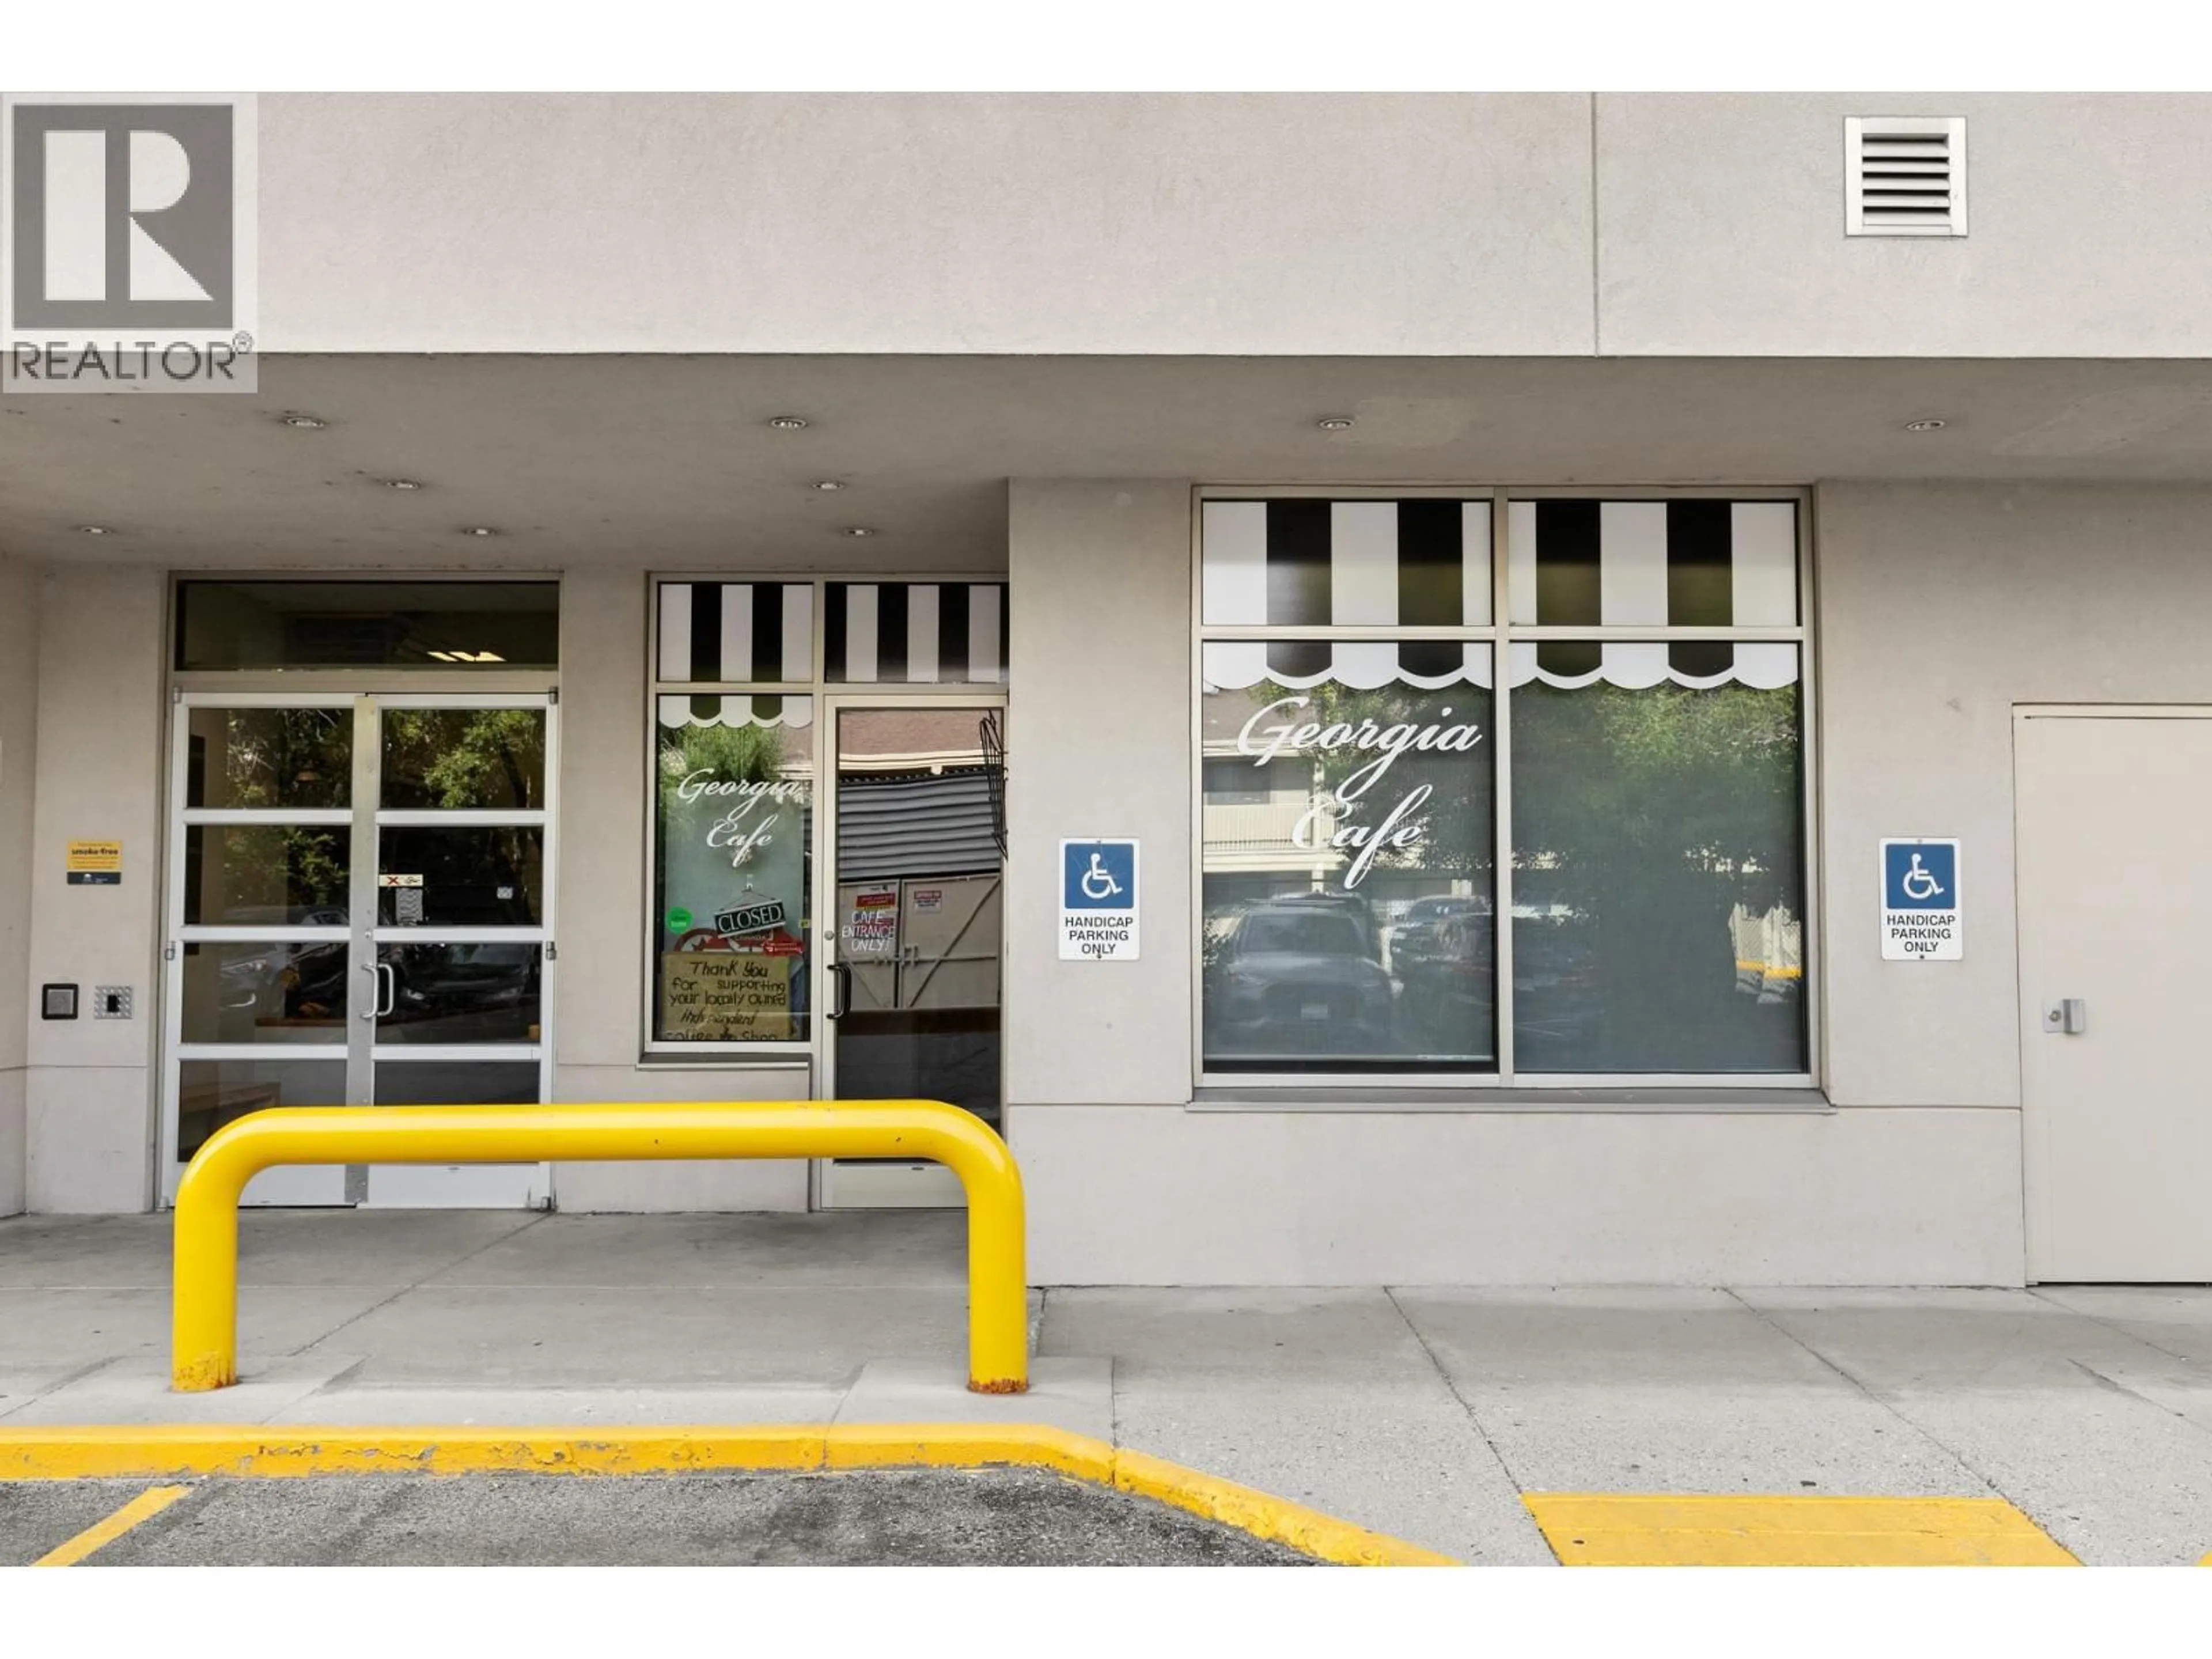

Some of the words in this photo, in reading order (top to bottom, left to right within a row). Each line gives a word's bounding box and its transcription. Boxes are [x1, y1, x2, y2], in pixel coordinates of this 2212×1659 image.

[1237, 696, 1483, 802] Georgia
[677, 768, 804, 823] Georgia
[719, 904, 782, 933] CLOSED
[1065, 916, 1134, 927] HANDICAP
[1887, 914, 1956, 926] HANDICAP
[841, 925, 895, 938] ENTRANCE
[1069, 930, 1129, 941] PARKING
[1891, 928, 1951, 940] PARKING
[1081, 943, 1116, 955] ONLY
[1904, 941, 1939, 952] ONLY
[690, 959, 738, 977] Thank
[672, 977, 698, 991] for
[717, 978, 786, 994] supporting
[669, 992, 699, 1007] your
[704, 990, 745, 1006] locally
